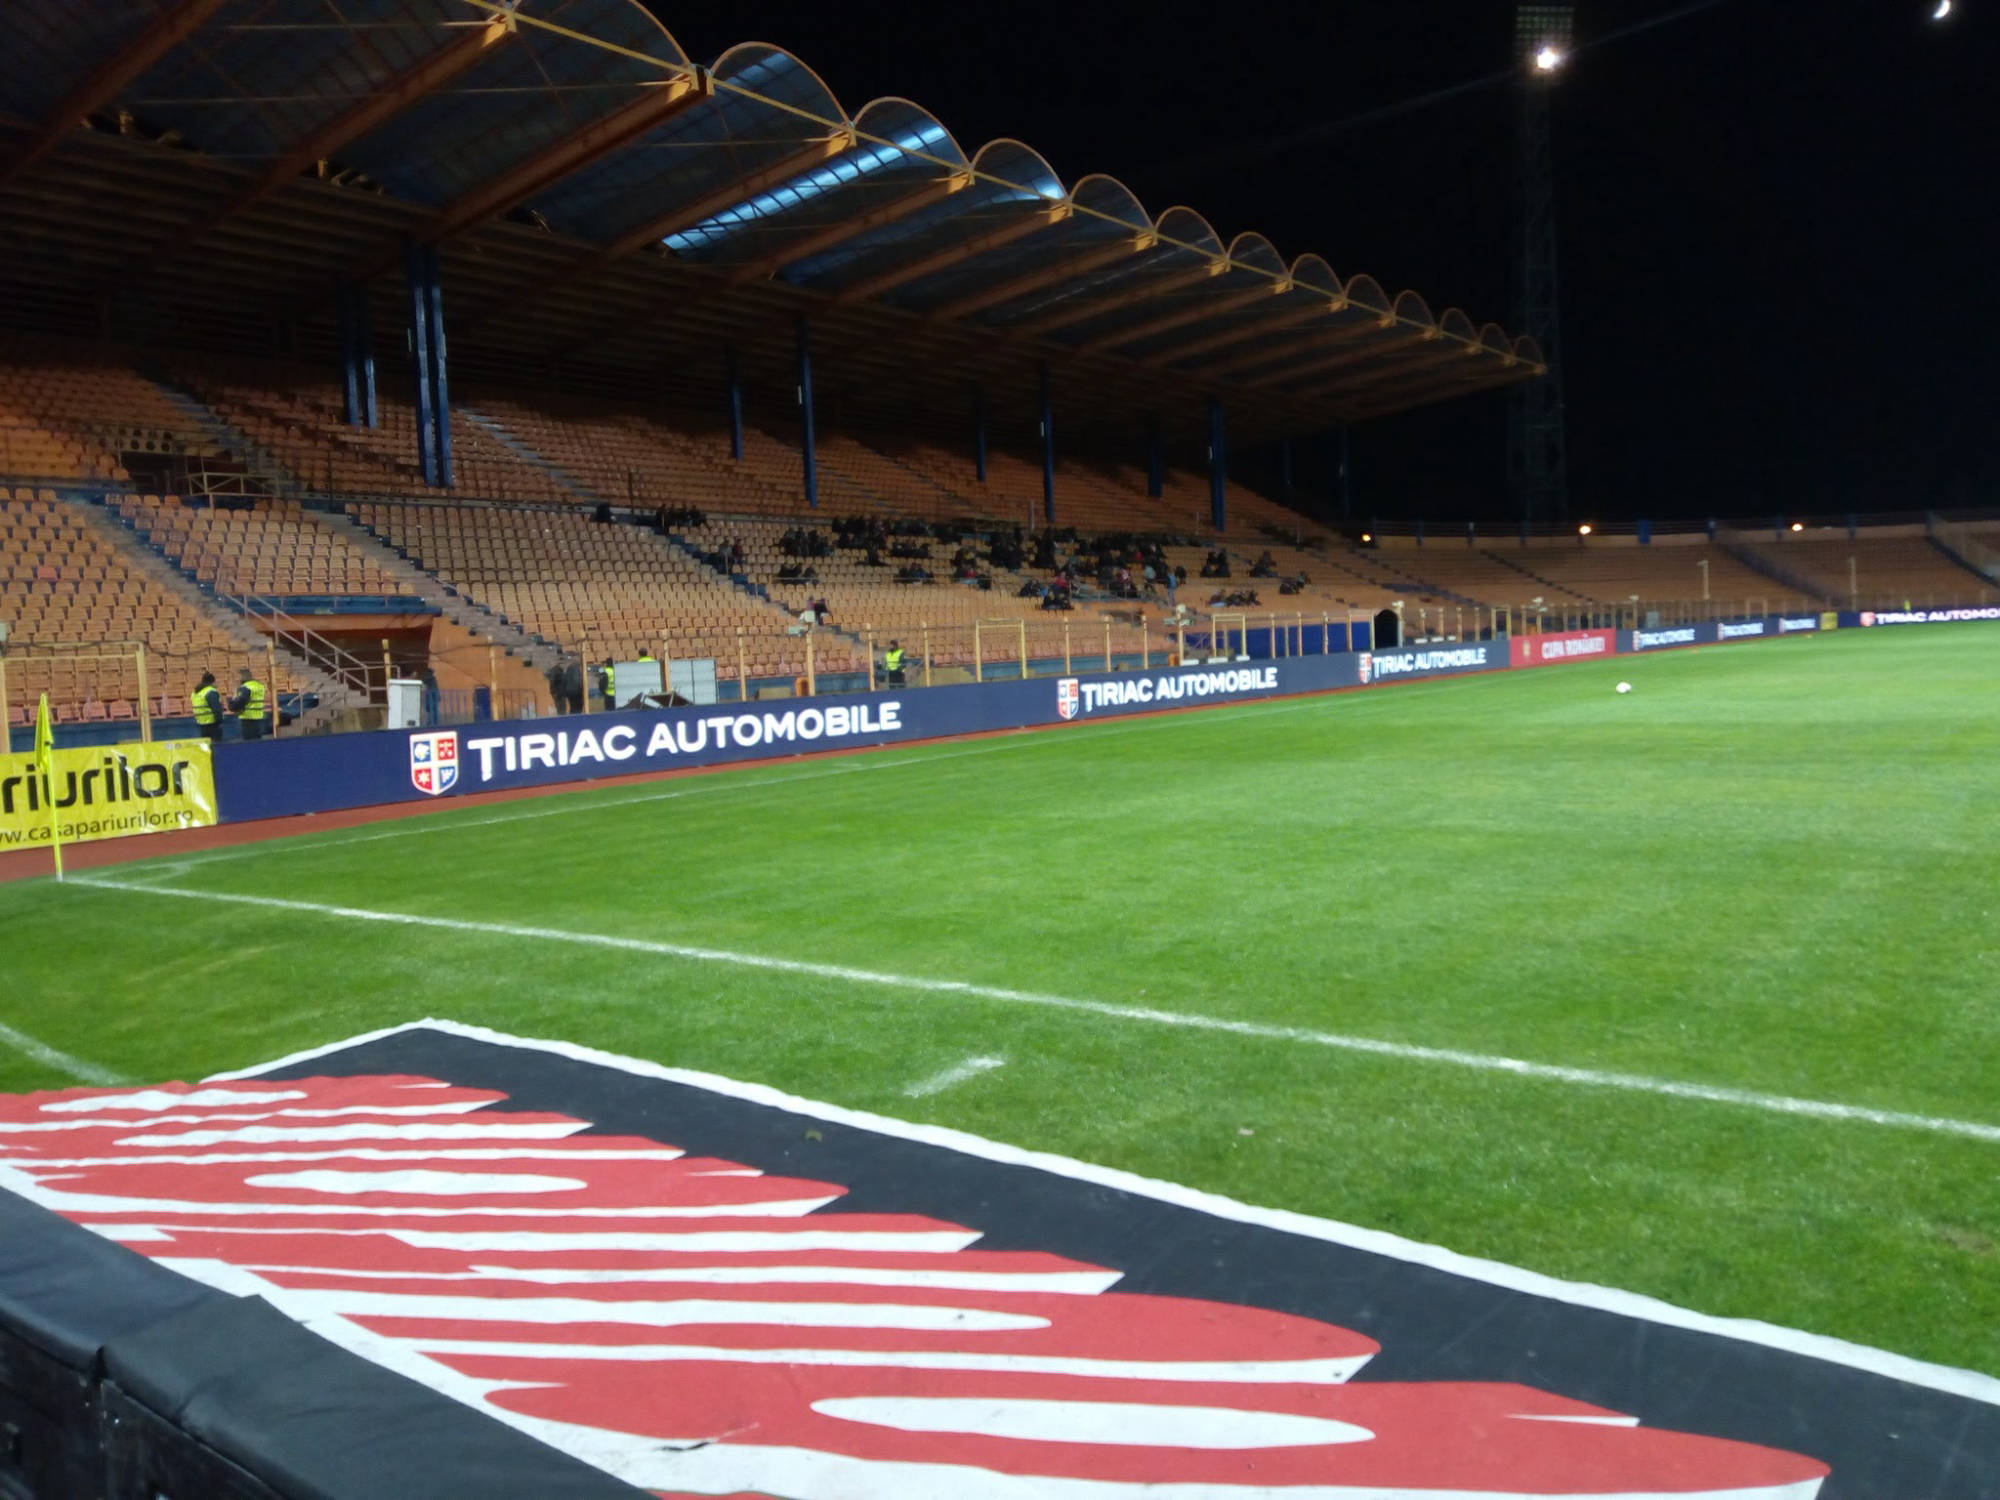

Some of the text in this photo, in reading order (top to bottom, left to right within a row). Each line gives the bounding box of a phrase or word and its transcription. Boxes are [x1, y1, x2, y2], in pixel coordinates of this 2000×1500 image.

[1928, 608, 2000, 621] AUTOMO
[1414, 647, 1487, 670] AUTOMOBILE
[1155, 667, 1278, 700] AUTOMOBILE
[646, 701, 902, 756] AUTOMOBILE
[0, 809, 194, 844] w.caapariurilor.ro
